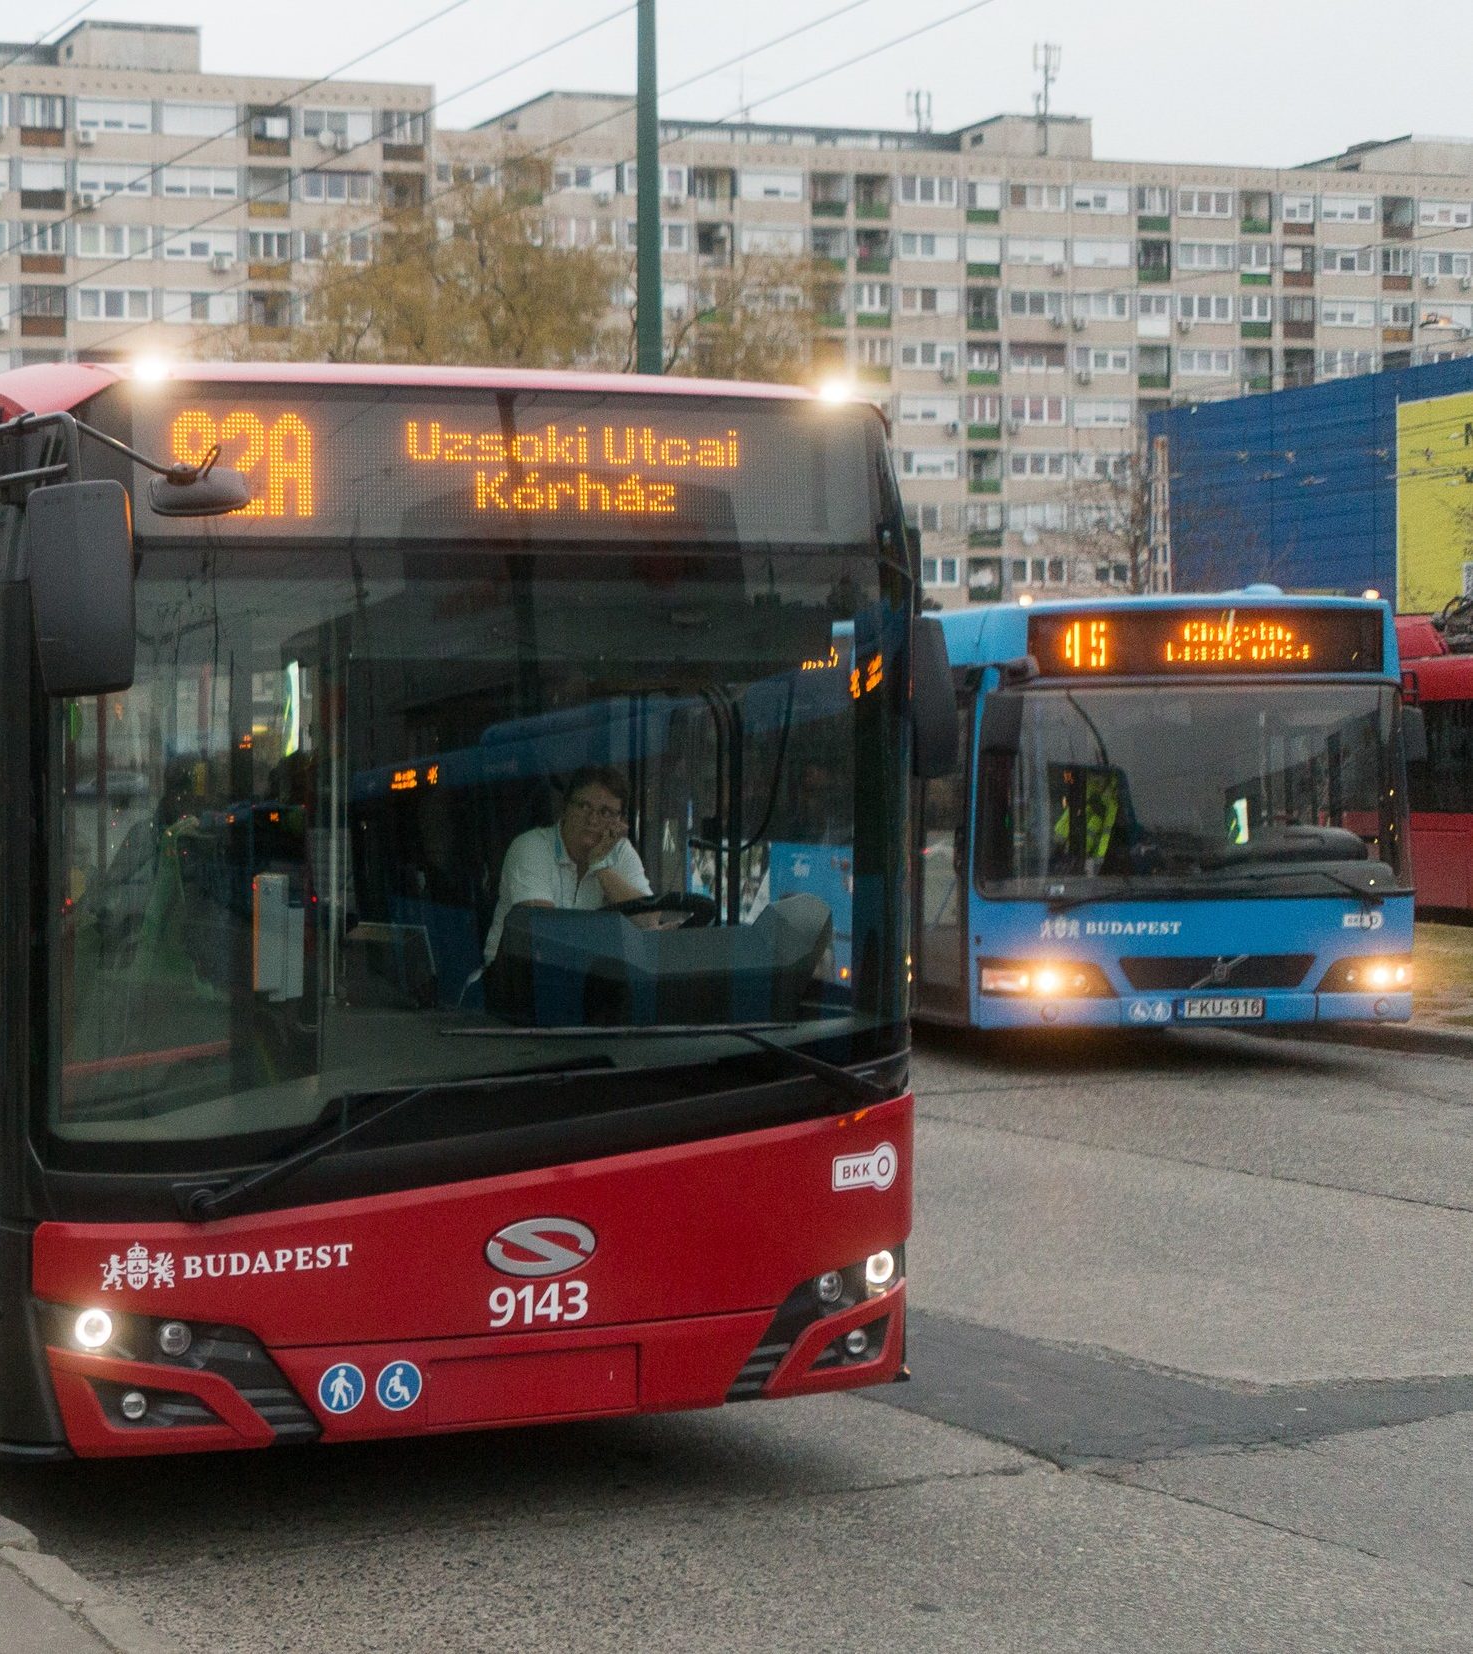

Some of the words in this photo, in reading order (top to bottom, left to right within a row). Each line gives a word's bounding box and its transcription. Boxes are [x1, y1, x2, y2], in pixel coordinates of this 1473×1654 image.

[406, 421, 588, 464] Uzsoki
[603, 425, 739, 468] Utcai
[475, 470, 676, 513] Kórház
[1085, 921, 1182, 936] BUDAPEST
[1186, 1000, 1261, 1017] FKU-916
[841, 1162, 872, 1180] BKK
[182, 1242, 354, 1280] BUDAPEST
[488, 1280, 589, 1328] 9143
